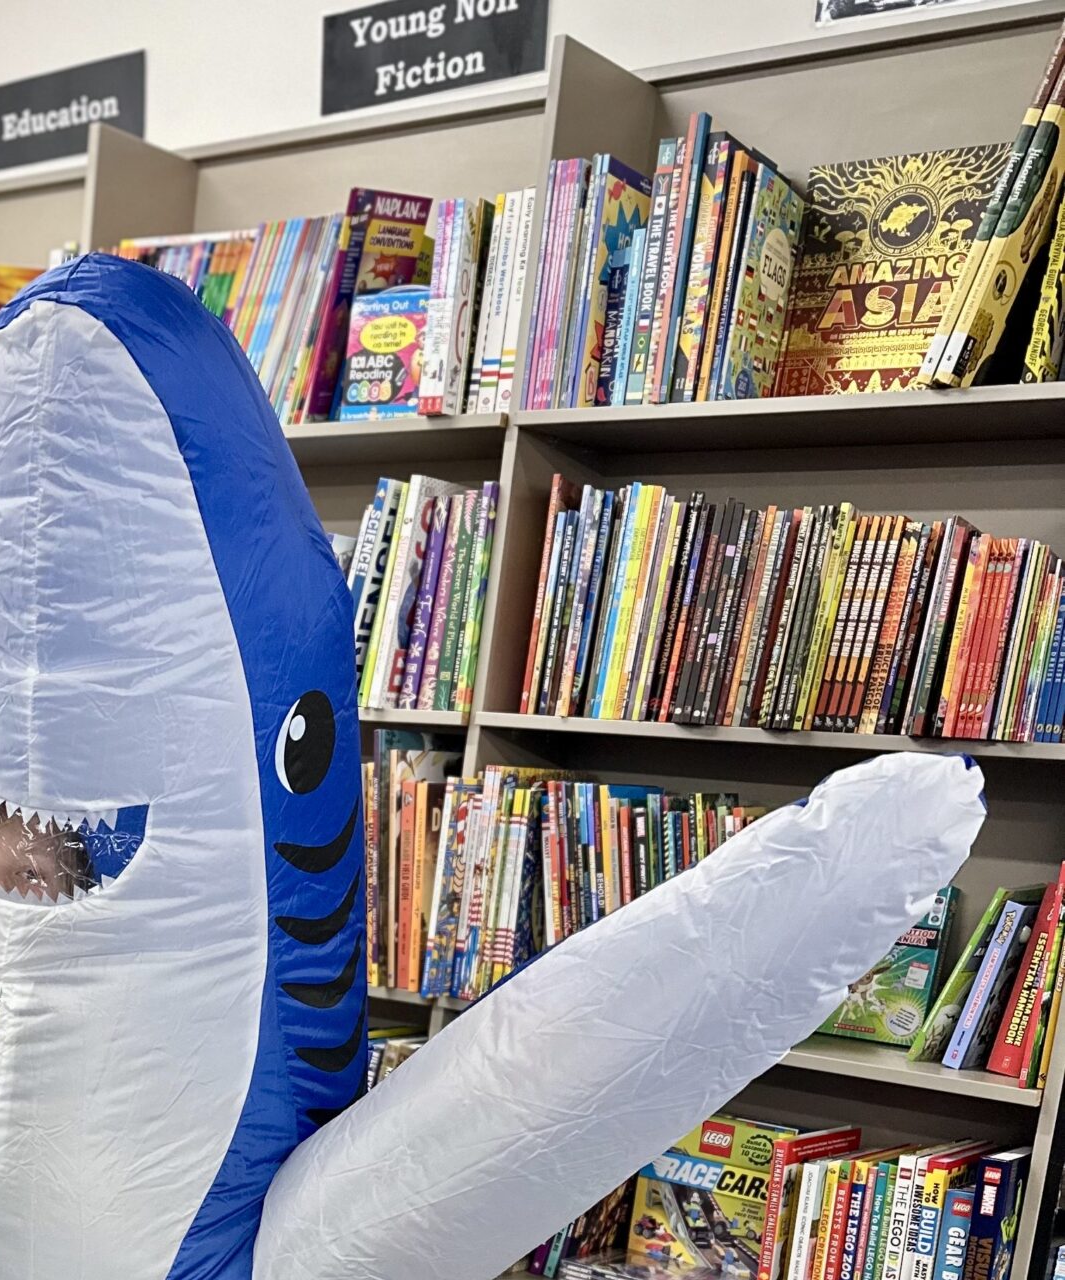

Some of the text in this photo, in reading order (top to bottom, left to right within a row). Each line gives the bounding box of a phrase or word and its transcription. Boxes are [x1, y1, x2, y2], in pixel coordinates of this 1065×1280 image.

[351, 2, 446, 48] Young
[375, 49, 486, 96] Fiction
[1, 95, 120, 141] Education
[1008, 148, 1044, 201] Historium
[374, 196, 418, 219] NAPLAN
[369, 234, 415, 251] CONVENTIONS
[377, 224, 412, 239] LANGUAGE
[640, 217, 664, 312] THE TRAVEL BOOK
[761, 255, 787, 288] FLAGS
[826, 253, 968, 288] AMAZING
[1042, 265, 1056, 290] GUIDE
[816, 281, 956, 332] ASIA
[1037, 308, 1048, 336] GEORGE
[599, 310, 618, 378] MANDARIN
[1030, 336, 1046, 368] IVANOFF
[349, 369, 392, 381] Reading
[367, 354, 394, 367] ABC
[355, 508, 381, 577] SCIENCE!
[450, 562, 466, 621] Secret World
[1003, 931, 1049, 1046] ESSENTIAL HANDBOOK
[703, 1130, 732, 1147] LEGO
[655, 1155, 721, 1189] RACE
[769, 1191, 781, 1212] FAMILY
[834, 1189, 846, 1230] BEASTS
[875, 1194, 883, 1213] How
[895, 1184, 910, 1210] THE
[924, 1191, 931, 1204] TO
[931, 1182, 940, 1206] HOW
[952, 1201, 971, 1214] LEGO
[980, 1184, 997, 1216] MARVEL
[820, 1208, 830, 1235] LEGO
[870, 1221, 879, 1243] Build
[889, 1211, 906, 1247] LEGO
[905, 1184, 924, 1253] AWESOME IDEAS
[916, 1208, 937, 1254] BUILD
[828, 1232, 840, 1264] FROM
[840, 1191, 863, 1280] THE LEGO ZOO
[944, 1226, 967, 1267] GEAR
[761, 1251, 772, 1268] BOOK
[866, 1243, 876, 1271] LEGO
